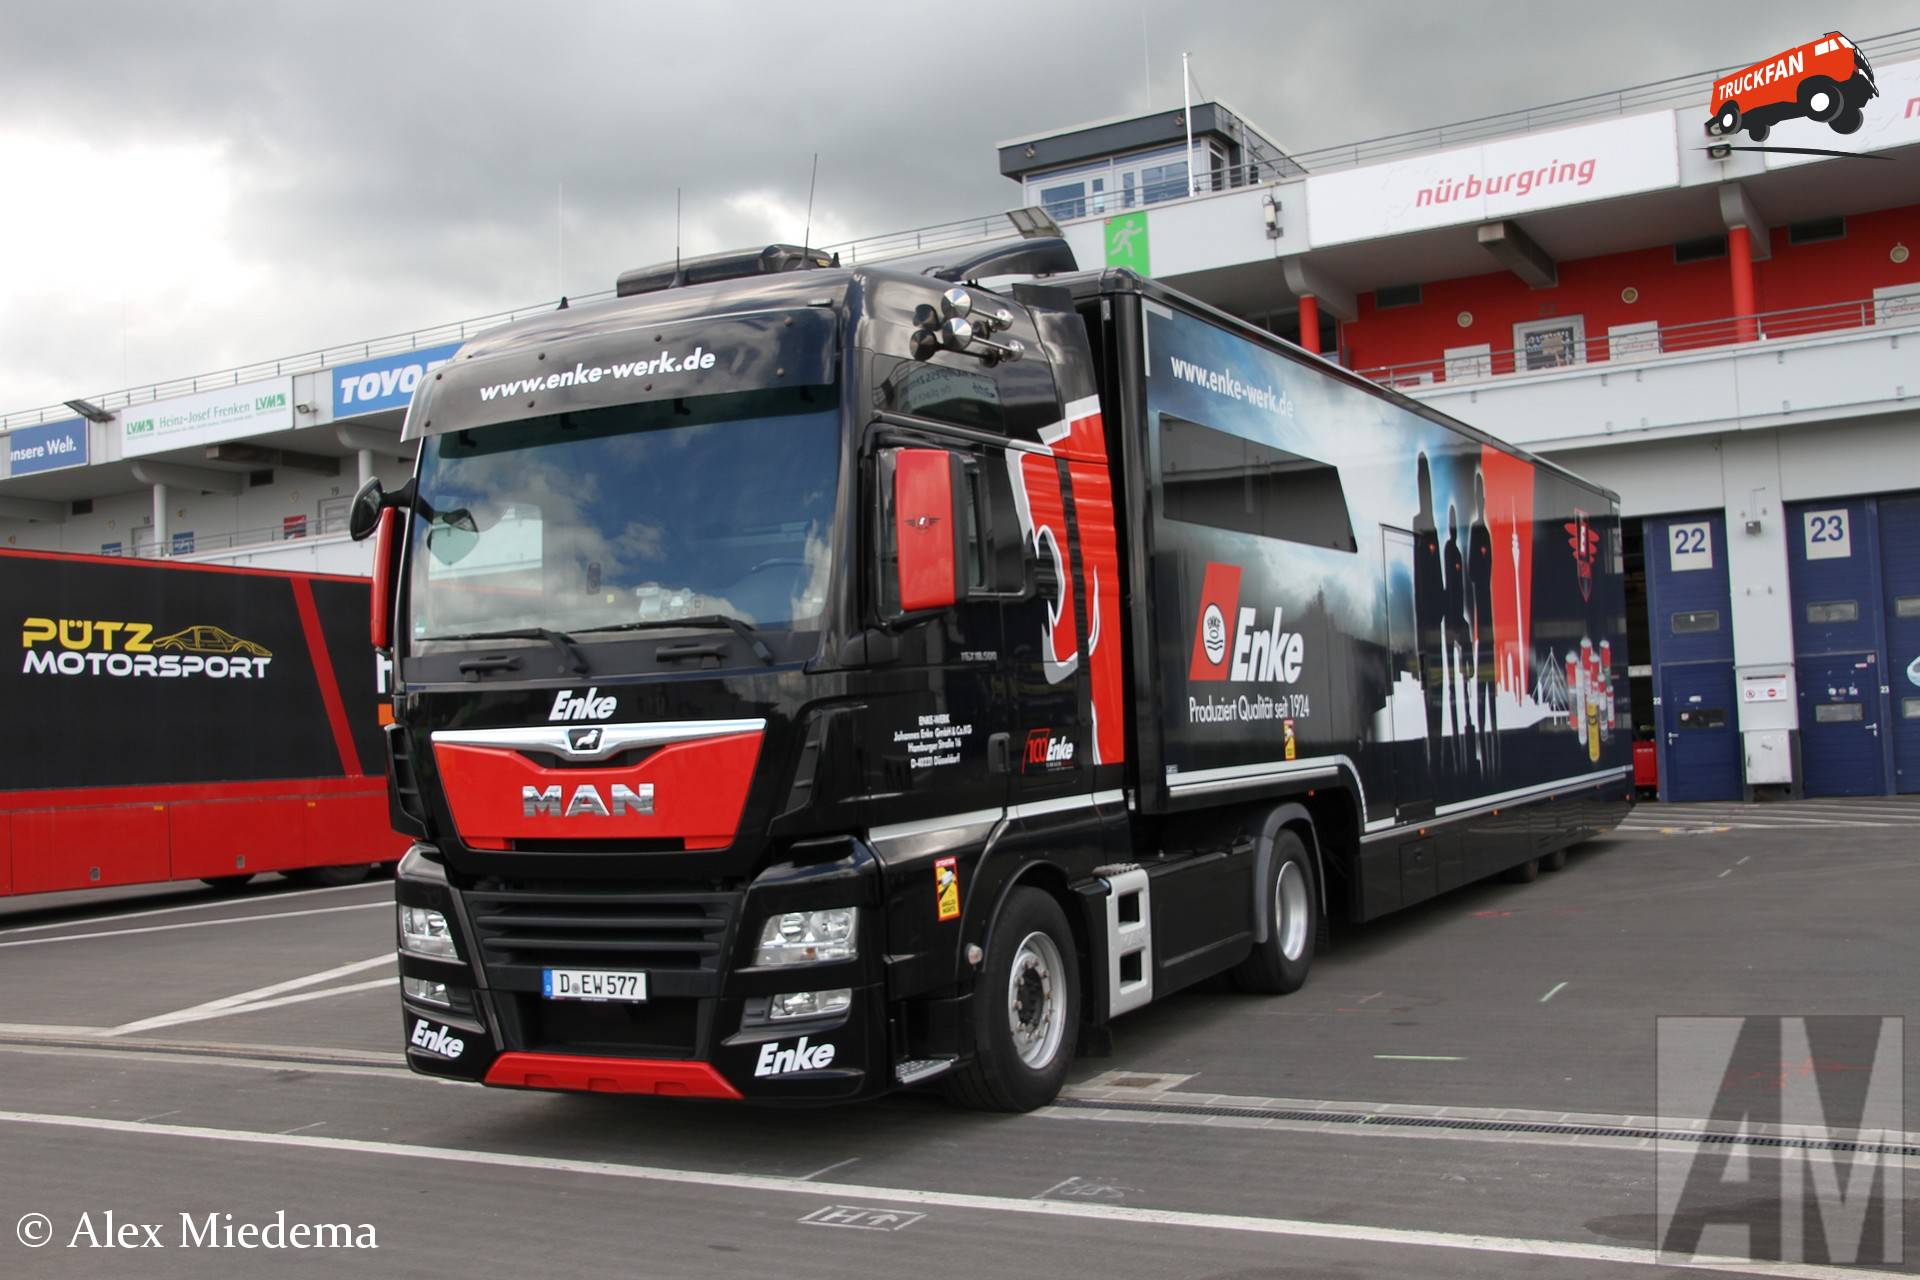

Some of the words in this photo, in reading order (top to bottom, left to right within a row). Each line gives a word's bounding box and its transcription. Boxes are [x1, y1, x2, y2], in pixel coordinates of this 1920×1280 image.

[1415, 158, 1597, 207] nürburgring
[478, 346, 717, 402] www.enke-werk.de
[1170, 356, 1295, 418] www.enke-werk.de
[159, 409, 210, 428] Heinz-Josef
[213, 402, 250, 417] Frenken
[255, 395, 276, 411] LVM
[126, 421, 146, 435] LVM
[46, 434, 77, 456] Welt.
[1675, 528, 1706, 554] 22
[1811, 515, 1844, 543] 23
[22, 617, 153, 652] PÜTZ
[1230, 606, 1304, 684] Enke
[22, 650, 272, 679] MOTORSPORT
[548, 687, 618, 721] Enke
[1189, 694, 1237, 724] Produziert
[1238, 694, 1274, 722] Qualität
[1274, 697, 1289, 719] seit
[1290, 693, 1310, 718] 1924
[1046, 735, 1074, 762] Enke
[522, 783, 655, 817] MAN
[560, 974, 570, 993] D
[581, 974, 603, 994] EW
[606, 976, 637, 996] 577
[411, 1019, 465, 1059] Enke
[754, 1036, 836, 1078] Enke
